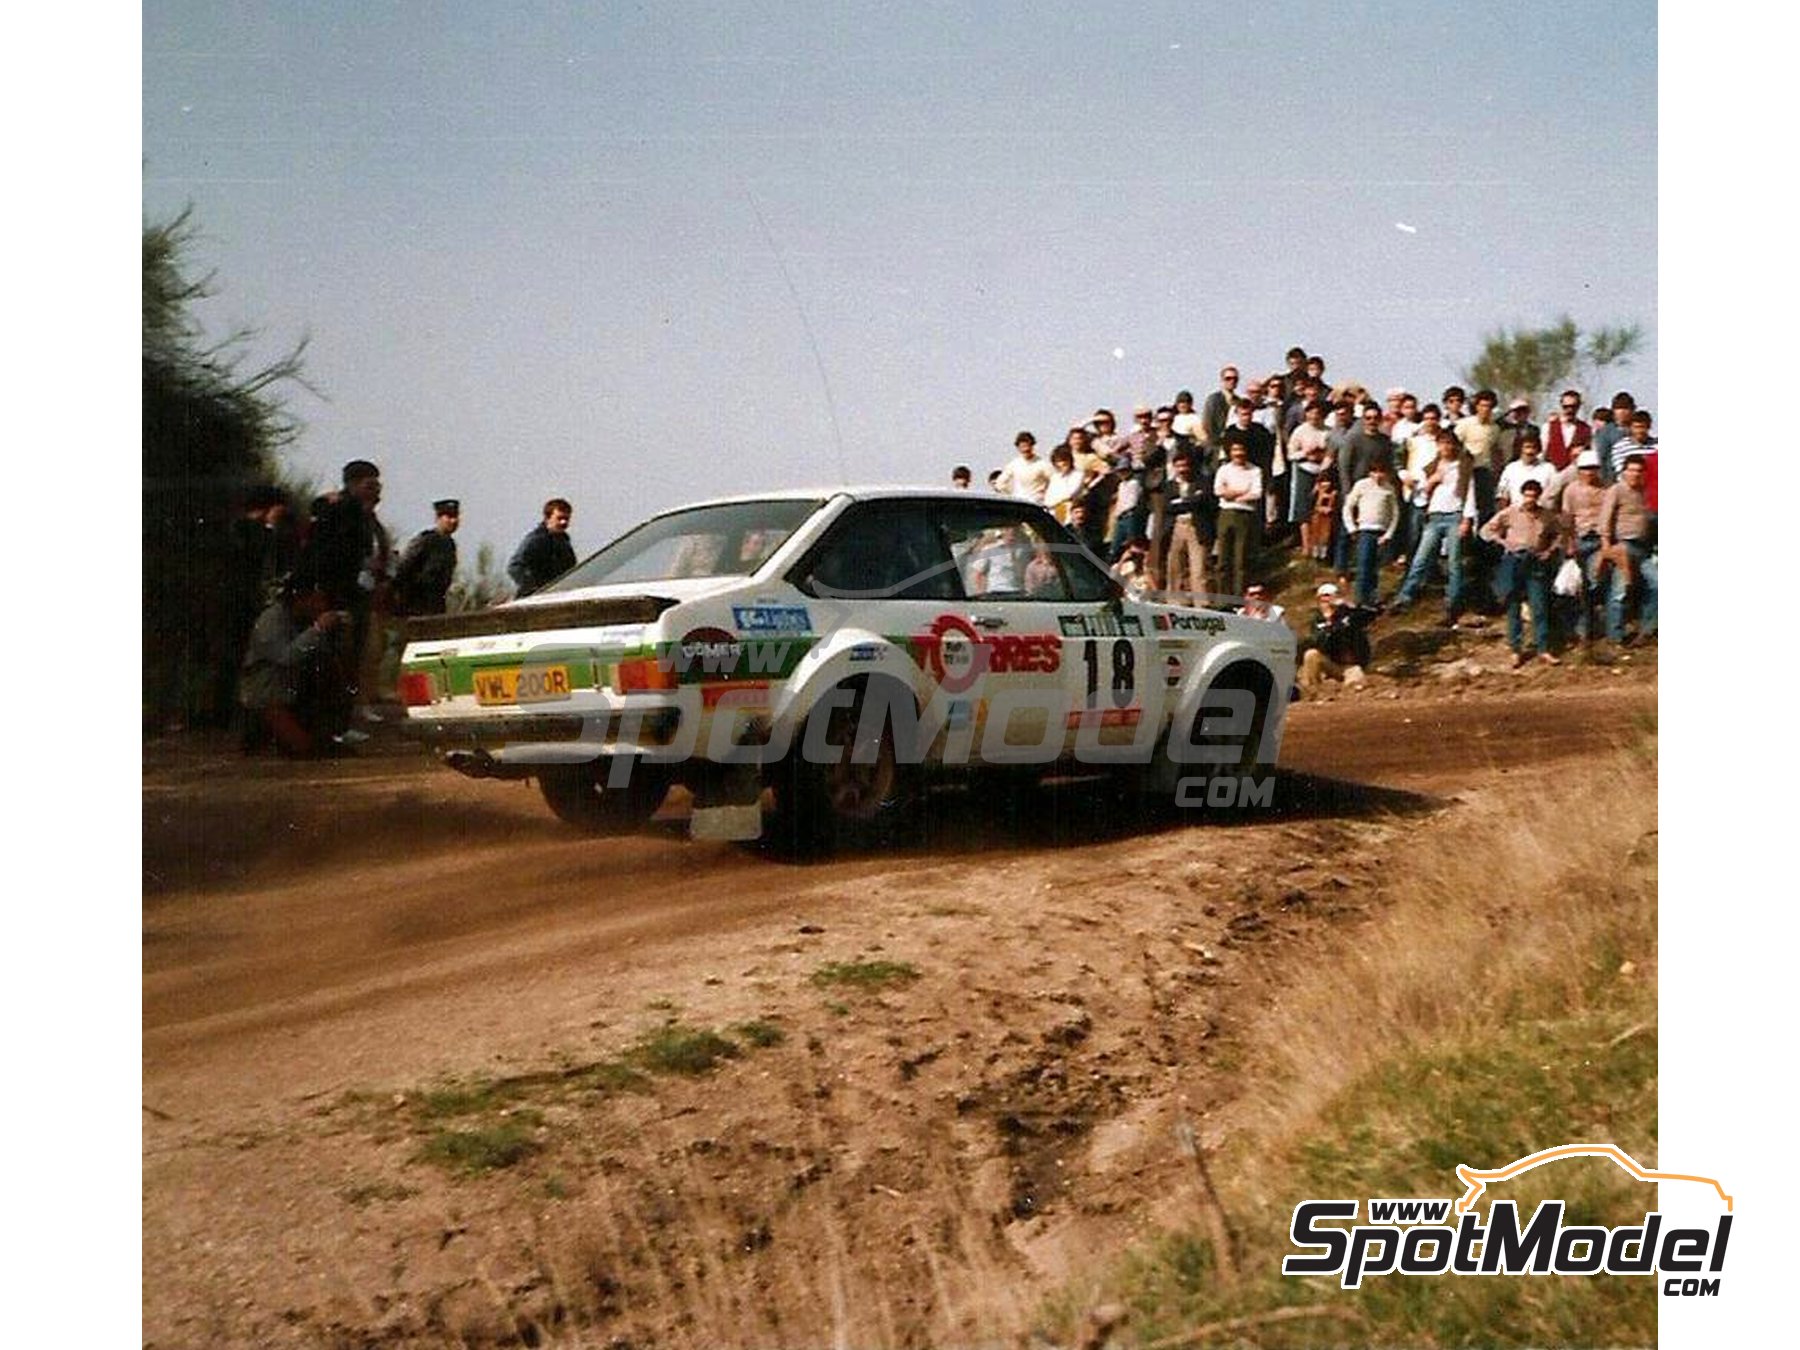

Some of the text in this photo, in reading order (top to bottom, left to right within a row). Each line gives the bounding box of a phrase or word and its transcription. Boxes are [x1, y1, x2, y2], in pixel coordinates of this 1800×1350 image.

[1171, 612, 1226, 636] Portugal
[909, 615, 1063, 694] TORRES
[1083, 638, 1135, 709] 18
[475, 668, 567, 699] VWL 200R
